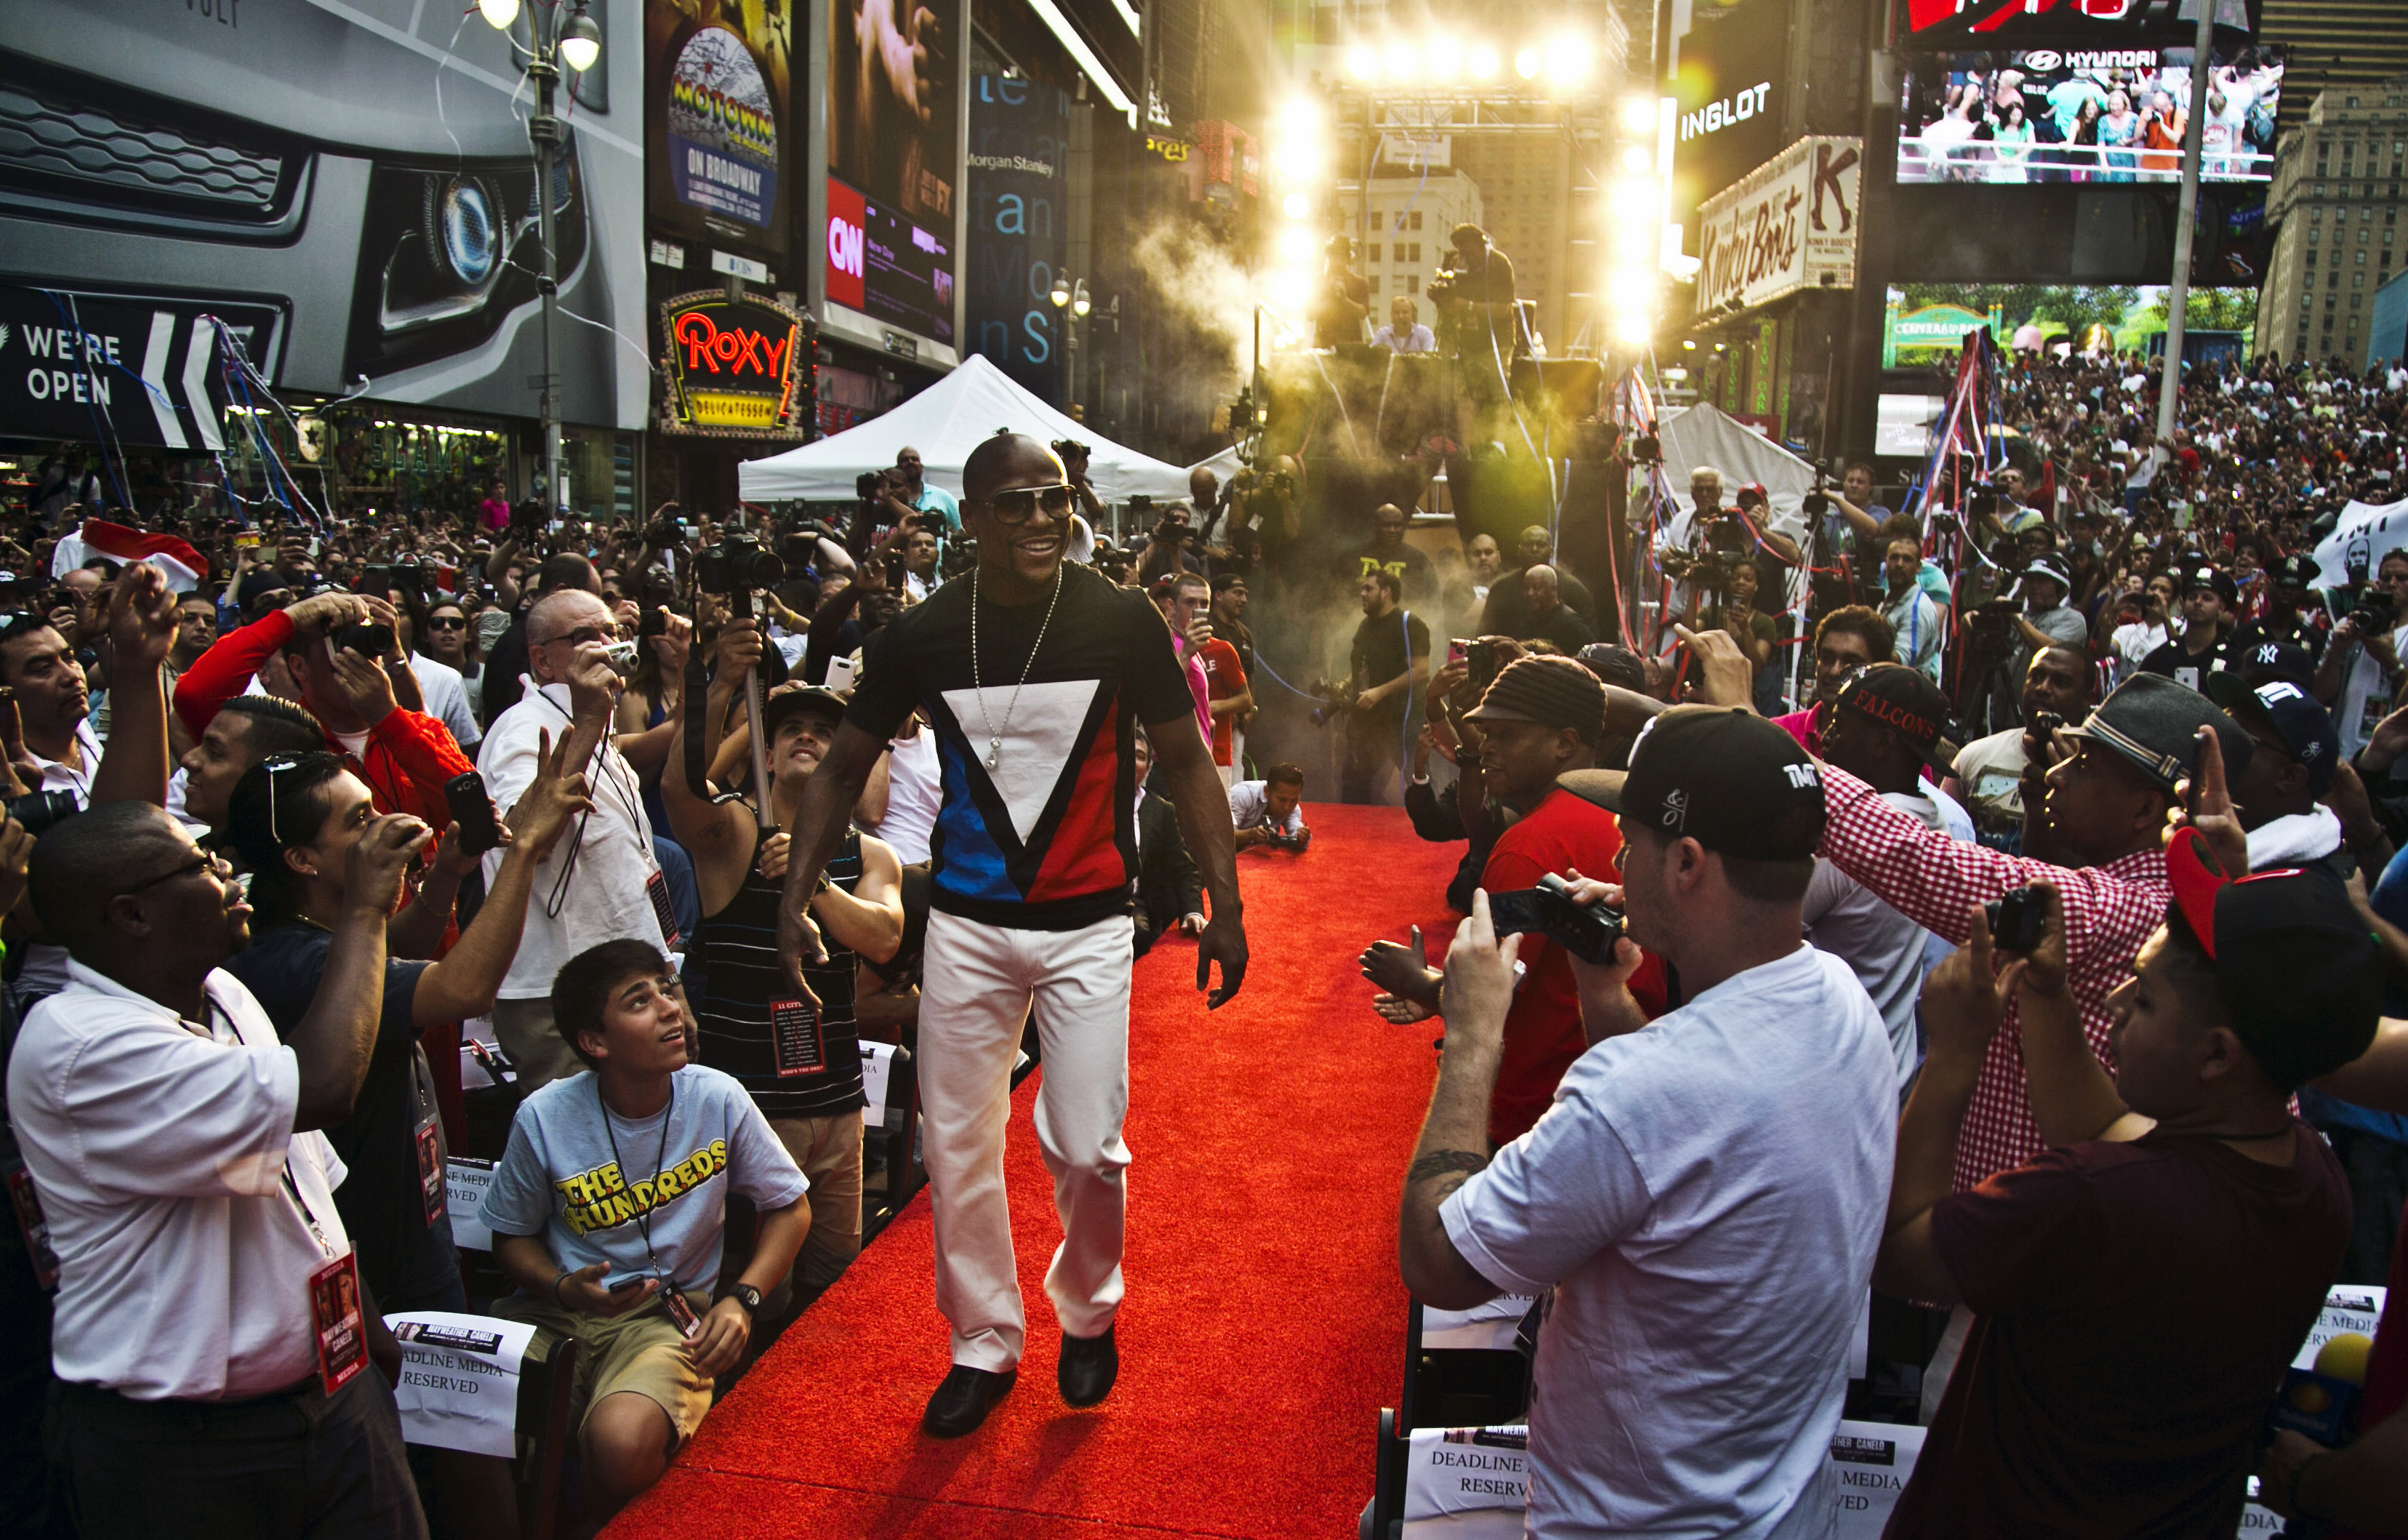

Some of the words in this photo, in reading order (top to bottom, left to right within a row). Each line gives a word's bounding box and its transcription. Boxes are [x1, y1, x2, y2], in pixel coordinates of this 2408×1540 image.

[2065, 50, 2157, 68] HYUNDAI
[672, 74, 773, 145] MOTOWN
[1681, 81, 1770, 142] INGLOT
[688, 148, 704, 176] ON
[706, 153, 761, 196] BROADWAY
[968, 153, 1012, 170] Morgan
[1014, 156, 1054, 178] Stanley
[1747, 184, 1803, 287] Boots
[828, 217, 863, 278] CNN
[22, 324, 121, 365] WE'RE
[675, 312, 786, 379] ROXY
[28, 368, 111, 405] OPEN
[697, 399, 771, 417] DELICATESSEN
[2257, 643, 2279, 664] NY
[1852, 689, 1935, 739] FALCONS
[1783, 763, 1818, 789] TMT
[461, 1173, 490, 1187] MEDI
[426, 1324, 470, 1339] MAYWEATHER
[470, 1329, 495, 1342] CANELO
[337, 1361, 359, 1383] MEDIA
[403, 1349, 454, 1369] ADLINE
[457, 1357, 503, 1377] MEDIA
[404, 1371, 478, 1394] RESERVED
[1485, 1425, 1528, 1437] MAYWEATH
[1856, 1439, 1885, 1451] CANELO
[1432, 1451, 1523, 1472] DEADLINE
[1461, 1477, 1528, 1496] RESERV
[1842, 1471, 1902, 1491] MEDIA
[2244, 1513, 2278, 1530] DIA
